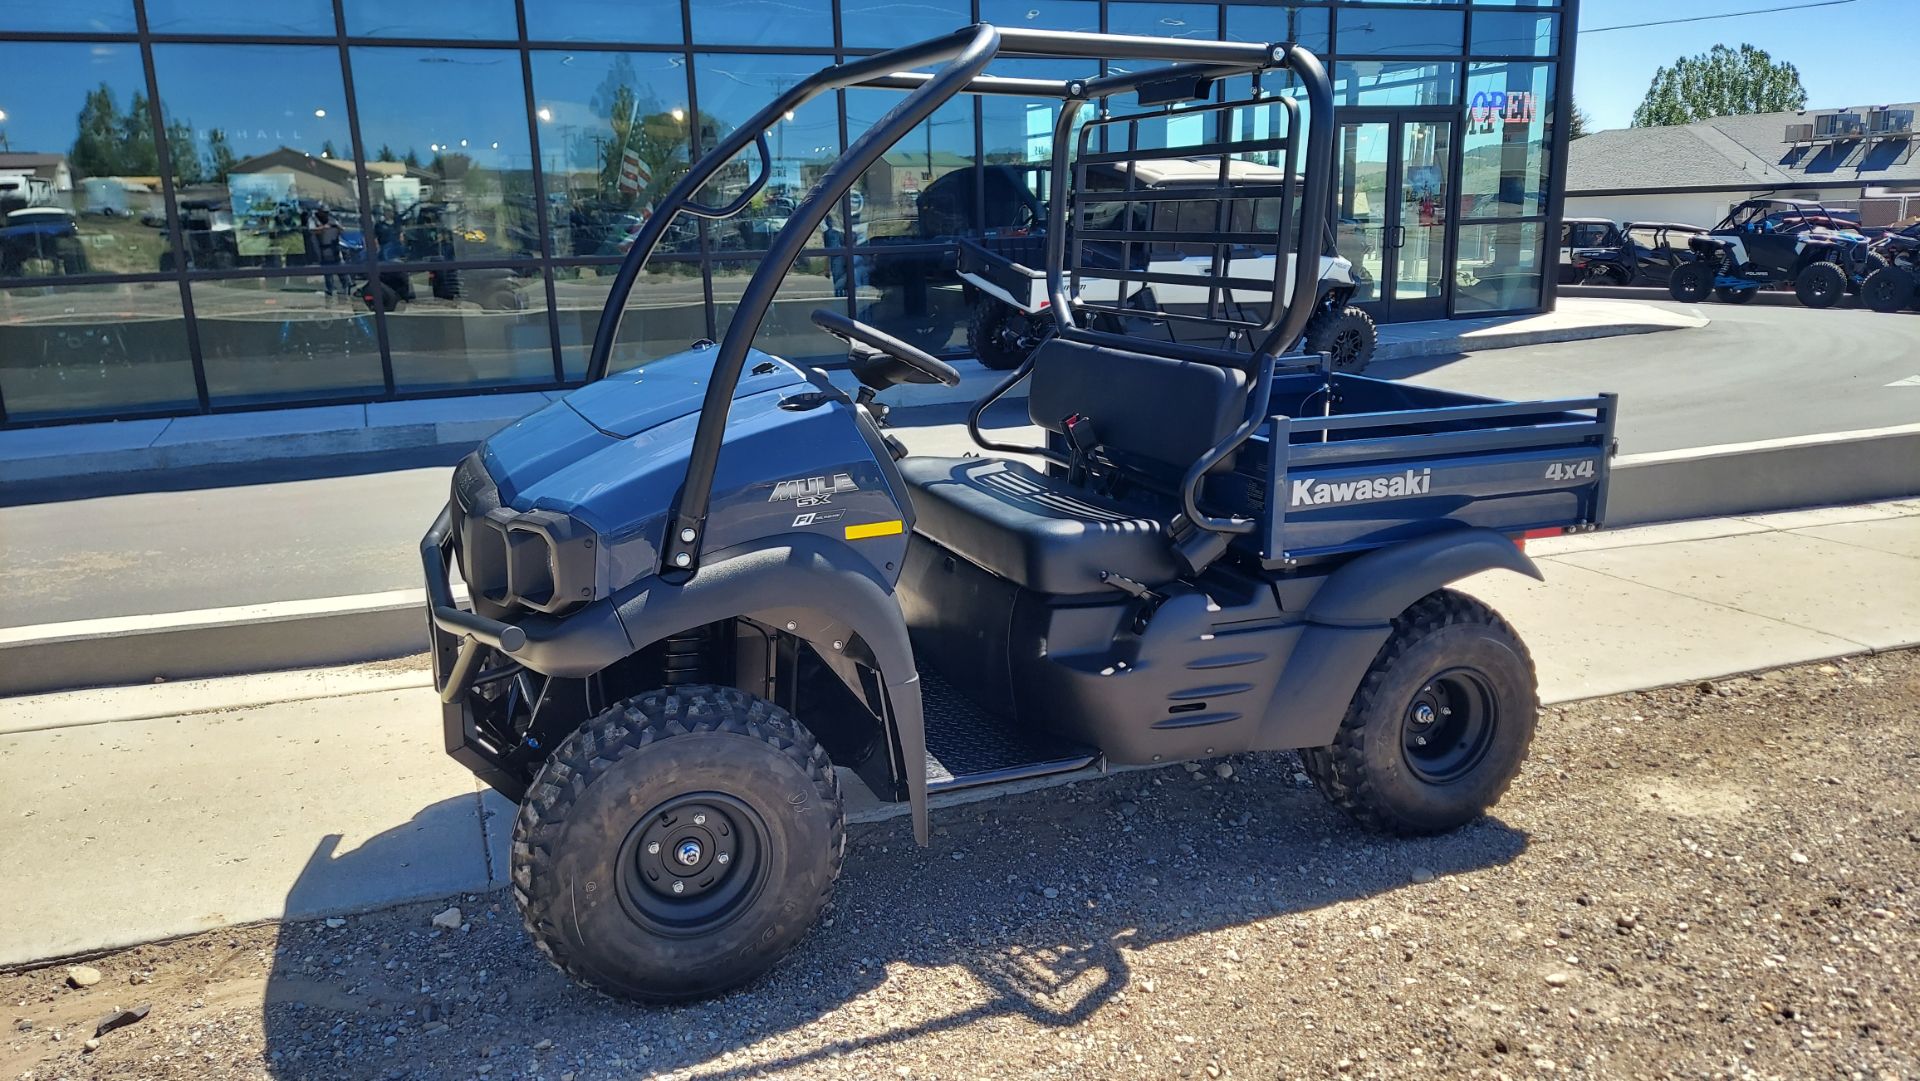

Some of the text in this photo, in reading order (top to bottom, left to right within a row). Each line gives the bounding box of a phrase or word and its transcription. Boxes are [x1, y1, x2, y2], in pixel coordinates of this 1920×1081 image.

[1471, 91, 1537, 123] OPEN
[1544, 460, 1595, 481] 4x4
[768, 473, 860, 502] MULE
[1291, 468, 1431, 507] Kawasaki
[796, 494, 832, 508] SX
[794, 514, 813, 525] FI
